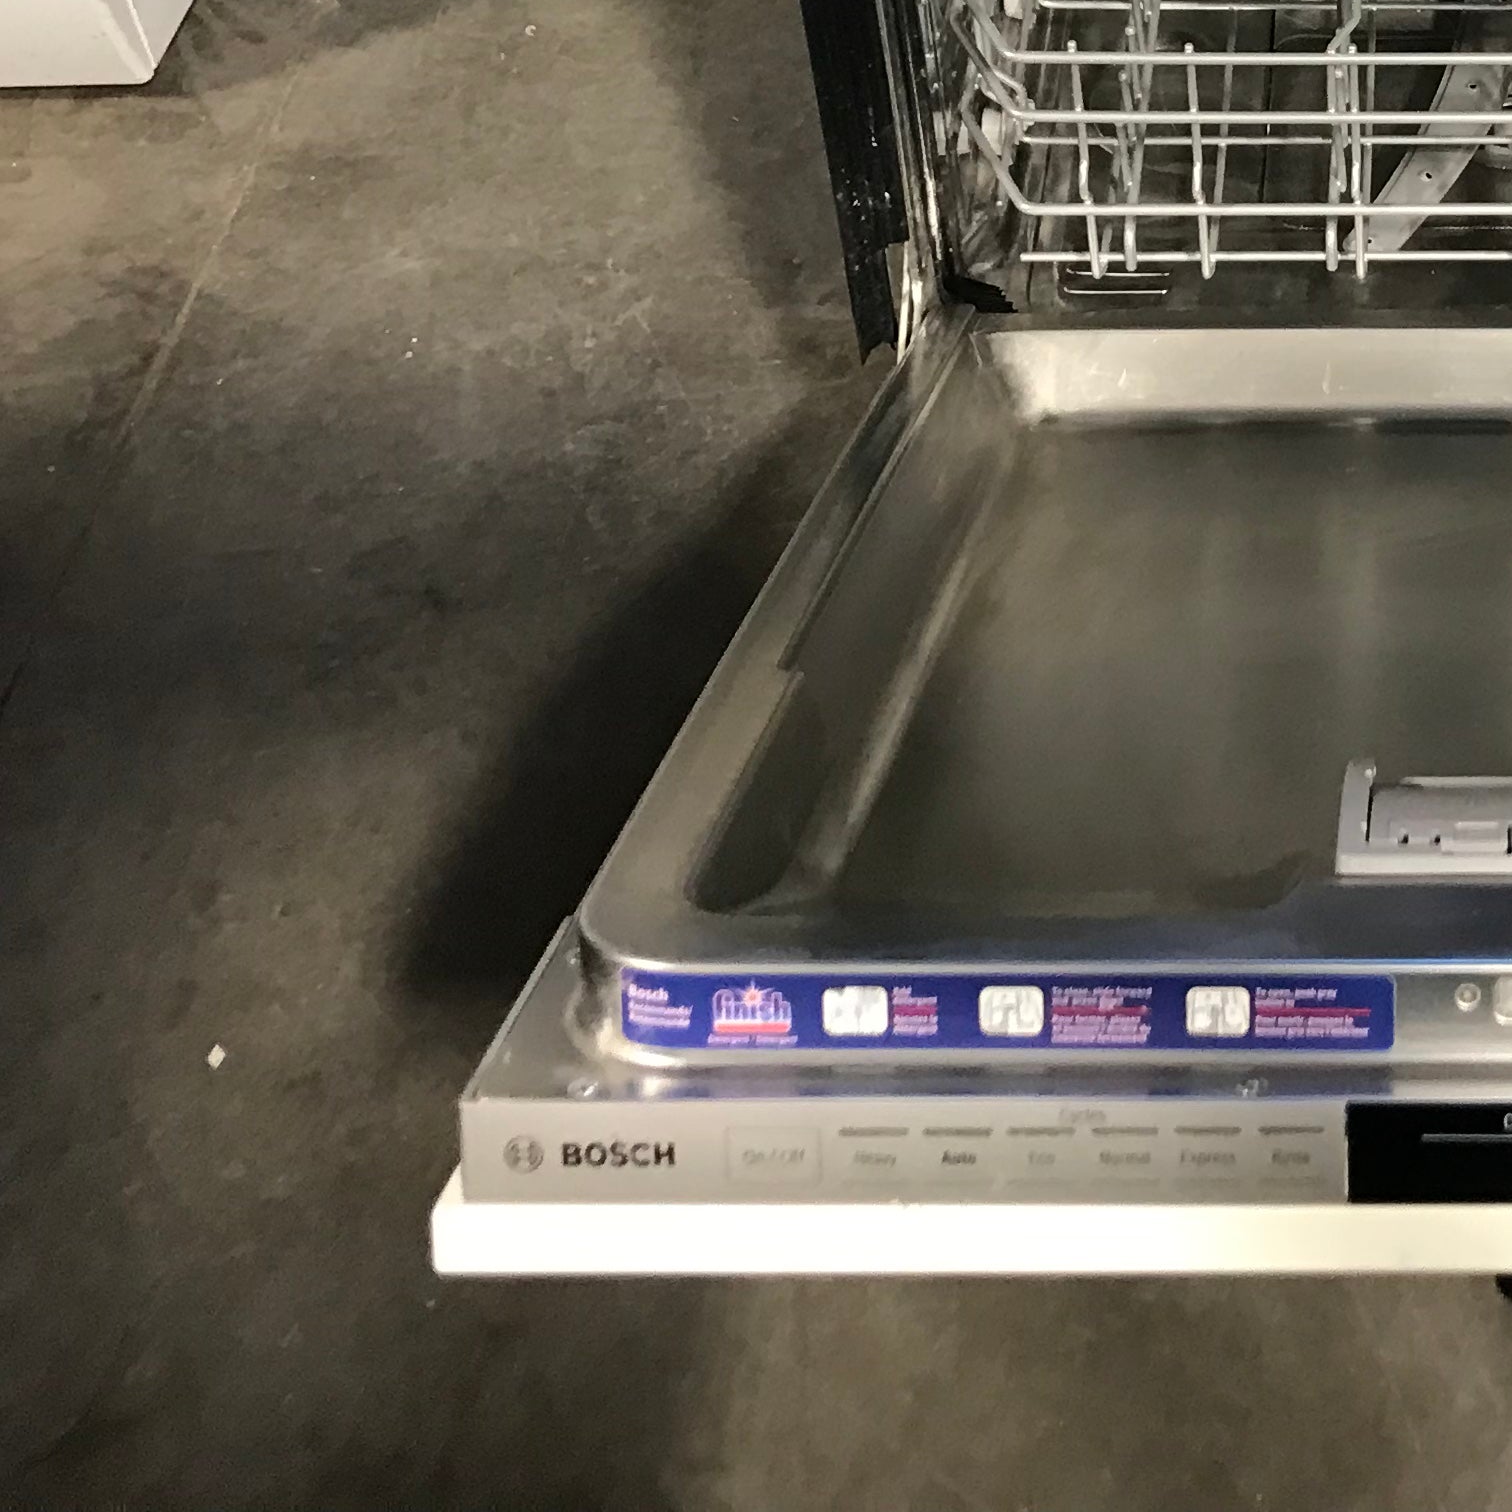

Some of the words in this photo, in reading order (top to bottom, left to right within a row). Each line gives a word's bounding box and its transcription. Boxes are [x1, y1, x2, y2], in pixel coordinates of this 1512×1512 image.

[560, 1142, 677, 1169] BOSCH
[941, 1149, 977, 1166] Auto
[1098, 1149, 1152, 1165] Normal
[1179, 1148, 1237, 1168] Express
